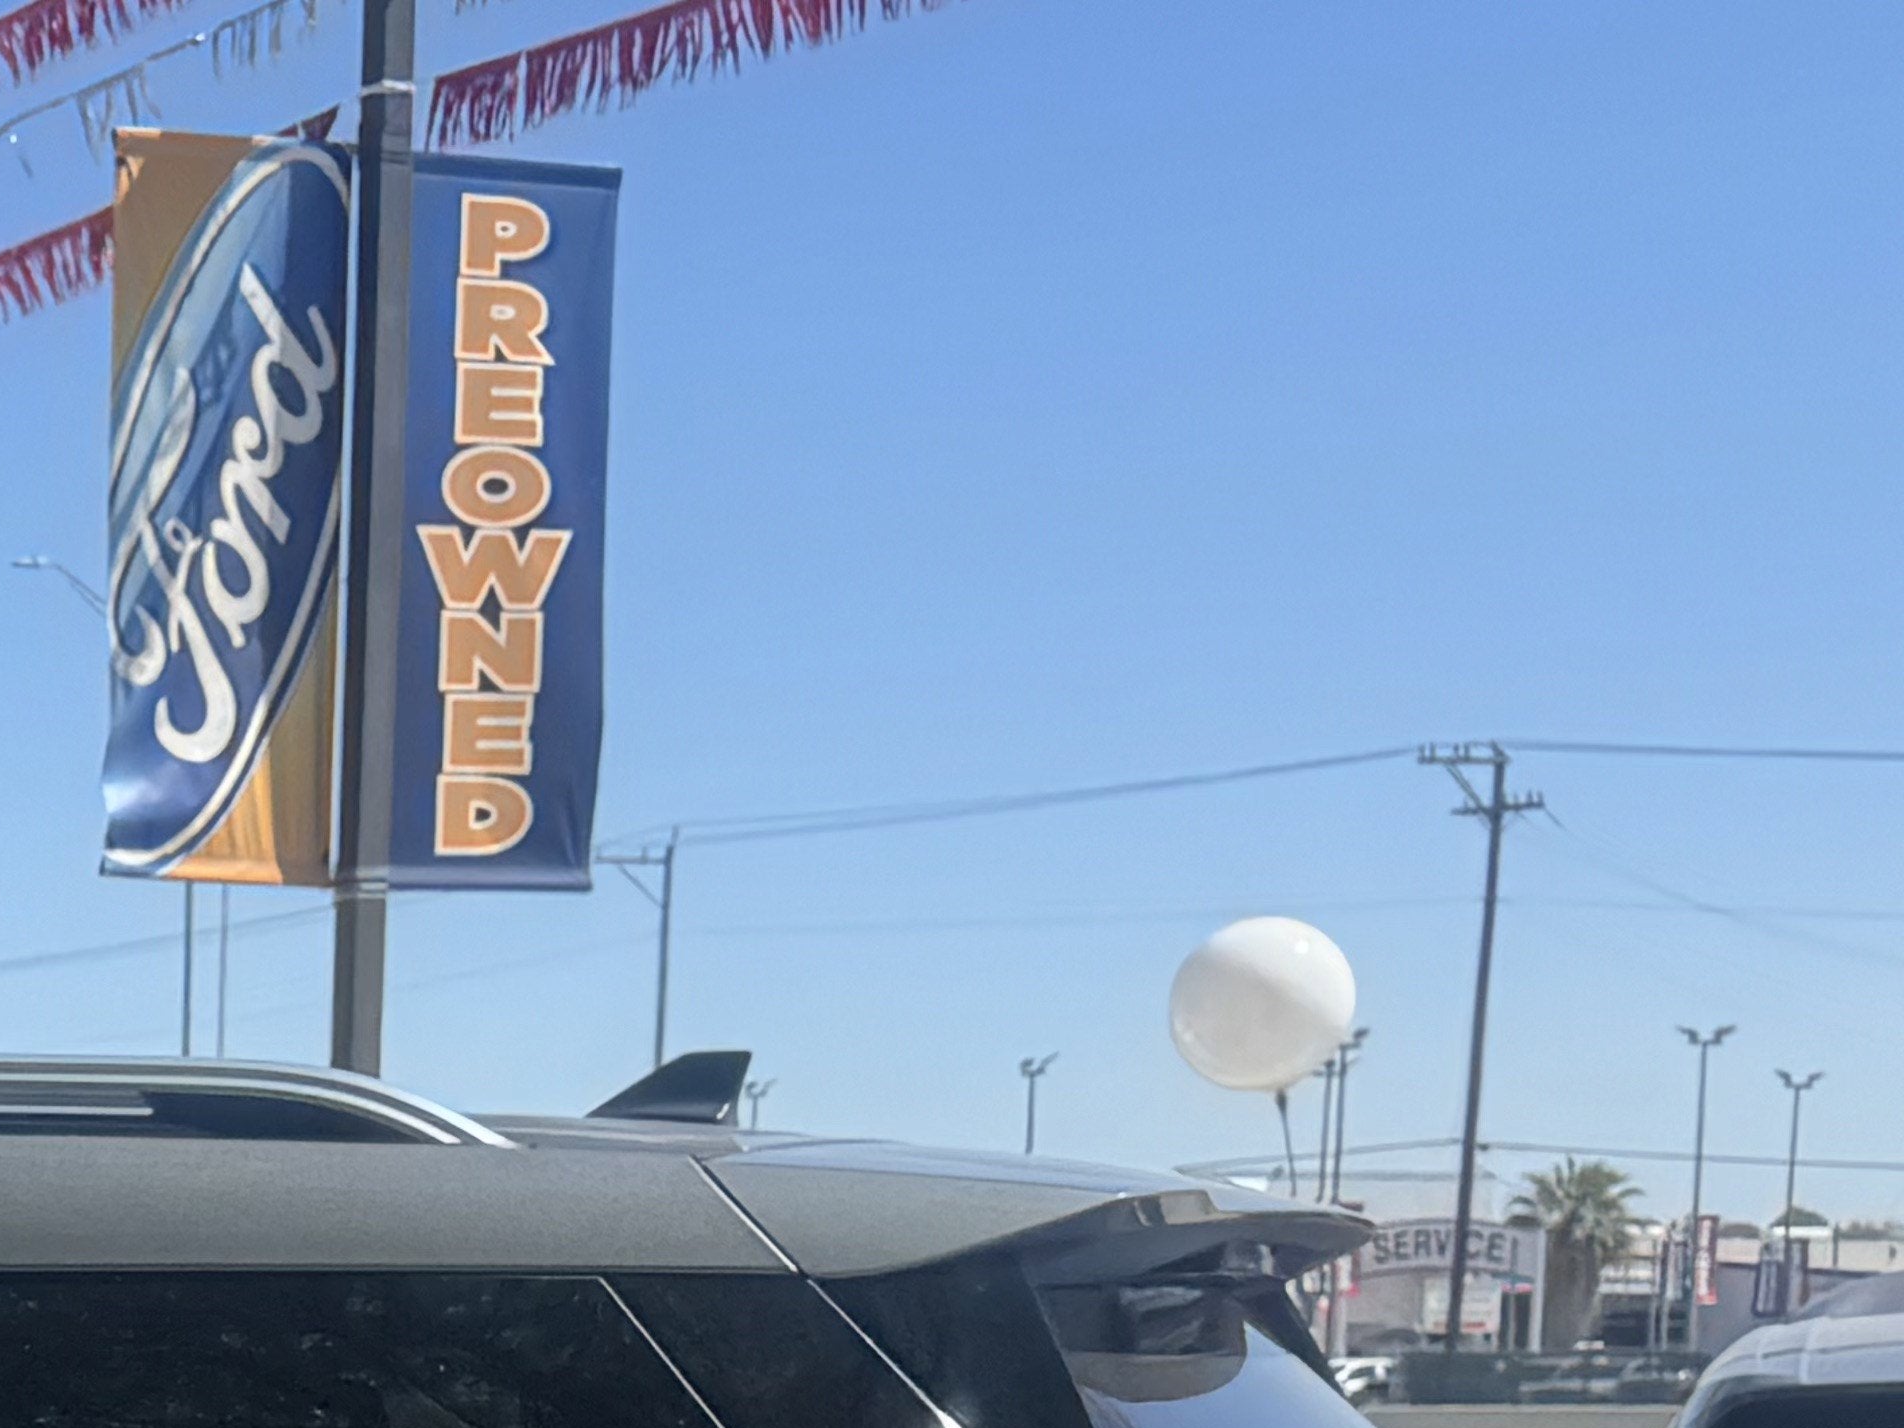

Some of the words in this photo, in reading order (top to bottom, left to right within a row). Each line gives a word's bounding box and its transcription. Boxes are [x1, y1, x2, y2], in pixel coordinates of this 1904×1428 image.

[108, 261, 340, 763] Ford
[415, 192, 573, 856] PREOWNED
[1372, 1229, 1506, 1264] SERVCE
